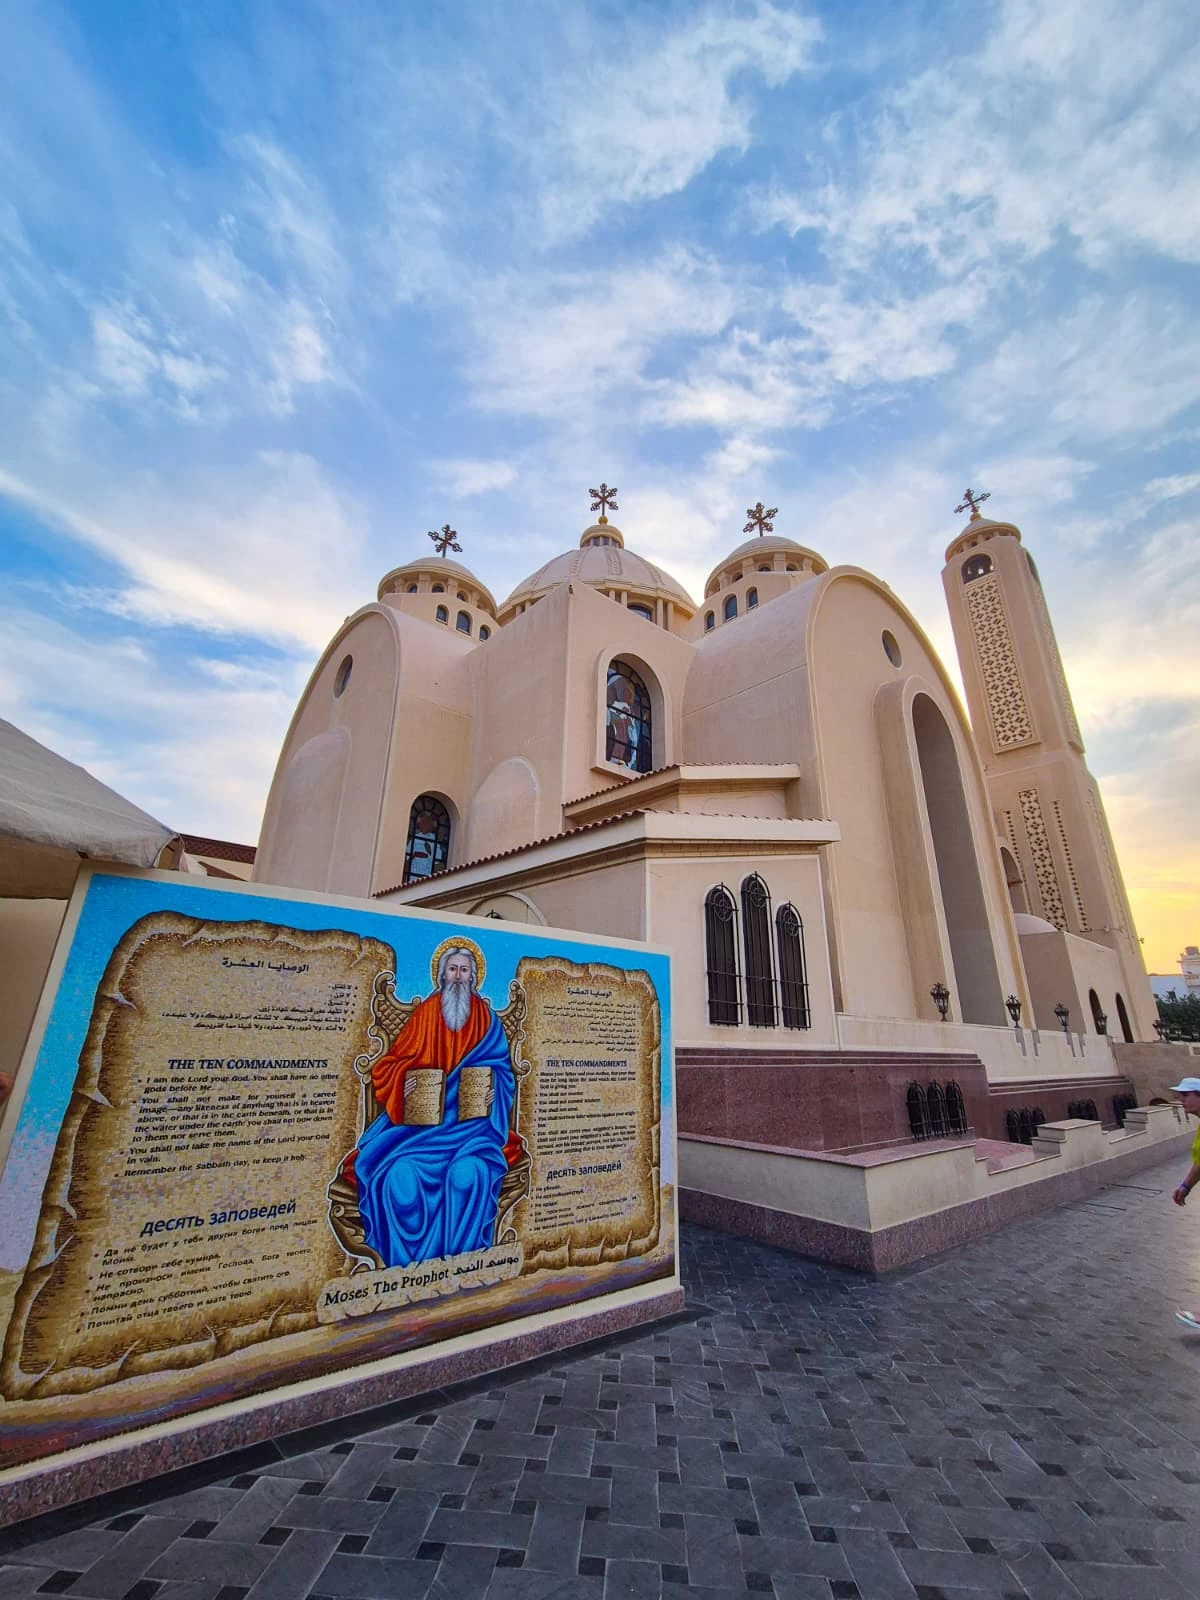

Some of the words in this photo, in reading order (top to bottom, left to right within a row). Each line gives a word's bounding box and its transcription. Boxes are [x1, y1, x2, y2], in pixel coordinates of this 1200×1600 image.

[222, 957, 264, 968] العشرة
[268, 961, 309, 974] الوصايا
[168, 1059, 195, 1070] THE
[198, 1059, 225, 1070] TEN
[227, 1059, 328, 1070] COMMANDMENTS
[144, 1085, 167, 1094] gods
[265, 1092, 296, 1100] yourself
[194, 1104, 230, 1112] likeness
[242, 1101, 275, 1110] anything
[149, 1144, 173, 1153] shall
[174, 1144, 190, 1152] not
[126, 1156, 136, 1164] in
[124, 1166, 177, 1177] Remember
[195, 1160, 231, 1170] Sabbath
[546, 1168, 576, 1181] десять
[578, 1160, 622, 1176] заповедей
[139, 1215, 204, 1238] десять
[208, 1199, 297, 1226] заповедей
[141, 1240, 169, 1252] будет
[98, 1270, 114, 1279] Не
[116, 1264, 158, 1276] сотвори
[160, 1259, 183, 1269] себе
[96, 1284, 111, 1292] Не
[324, 1286, 369, 1308] Moses
[373, 1280, 398, 1296] The
[401, 1269, 450, 1289] Prophet
[90, 1303, 128, 1315] Помни
[213, 1280, 240, 1290] чтобы
[87, 1314, 133, 1330] Почитай
[162, 1302, 194, 1314] твоего
